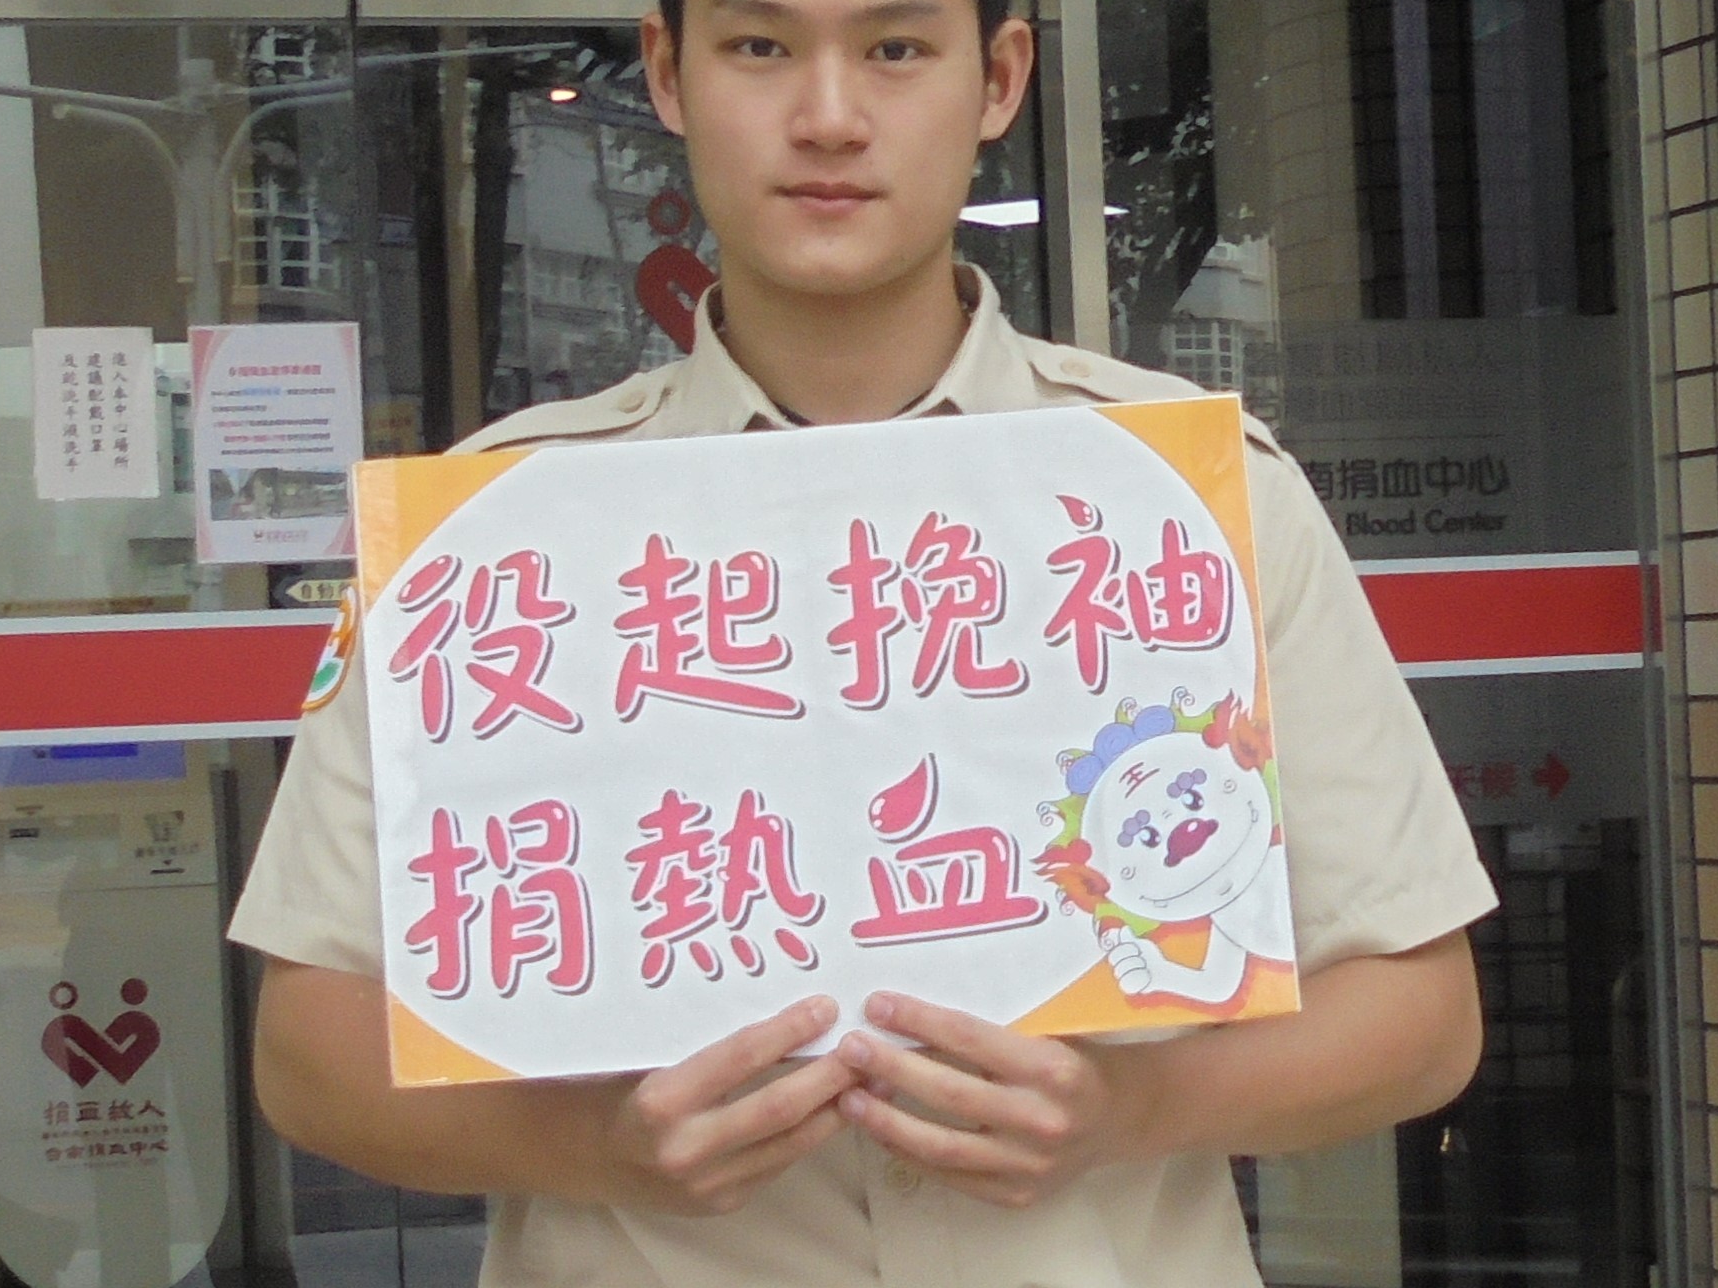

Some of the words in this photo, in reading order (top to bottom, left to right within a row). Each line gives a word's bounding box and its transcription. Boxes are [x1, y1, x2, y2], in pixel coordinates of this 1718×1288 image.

[1345, 510, 1419, 537] Blood
[1425, 509, 1508, 535] Center
[387, 493, 1234, 742] 役起挽袖
[402, 752, 1049, 1002] 捐熱血
[44, 1098, 166, 1126] 捐血救人
